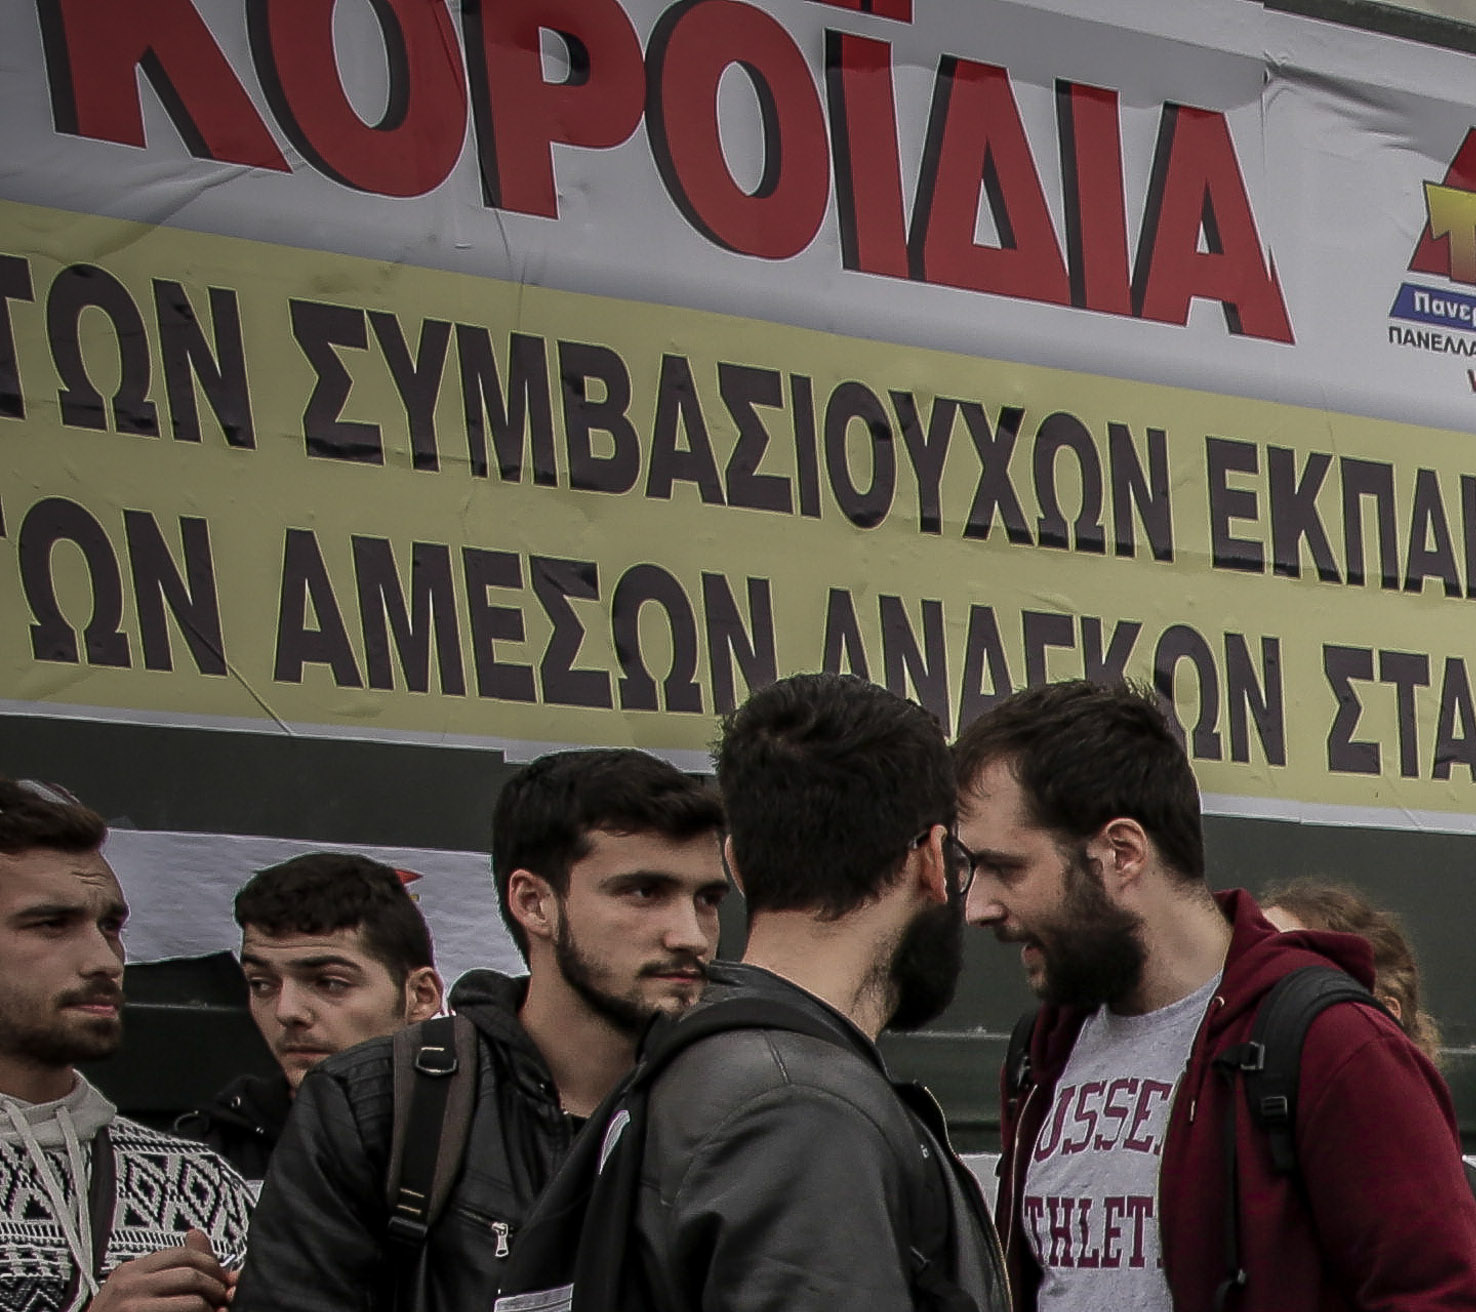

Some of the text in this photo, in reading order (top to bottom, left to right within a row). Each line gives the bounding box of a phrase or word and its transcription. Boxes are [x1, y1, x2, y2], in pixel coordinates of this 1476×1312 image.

[0, 254, 256, 451] ΤΩΝ
[288, 297, 1174, 563] ΣΥΜΒΑΣΙΟΥΧΩΝ
[0, 494, 228, 677] ΩΝ
[273, 527, 778, 716] ΑΜΕΣΩΝ
